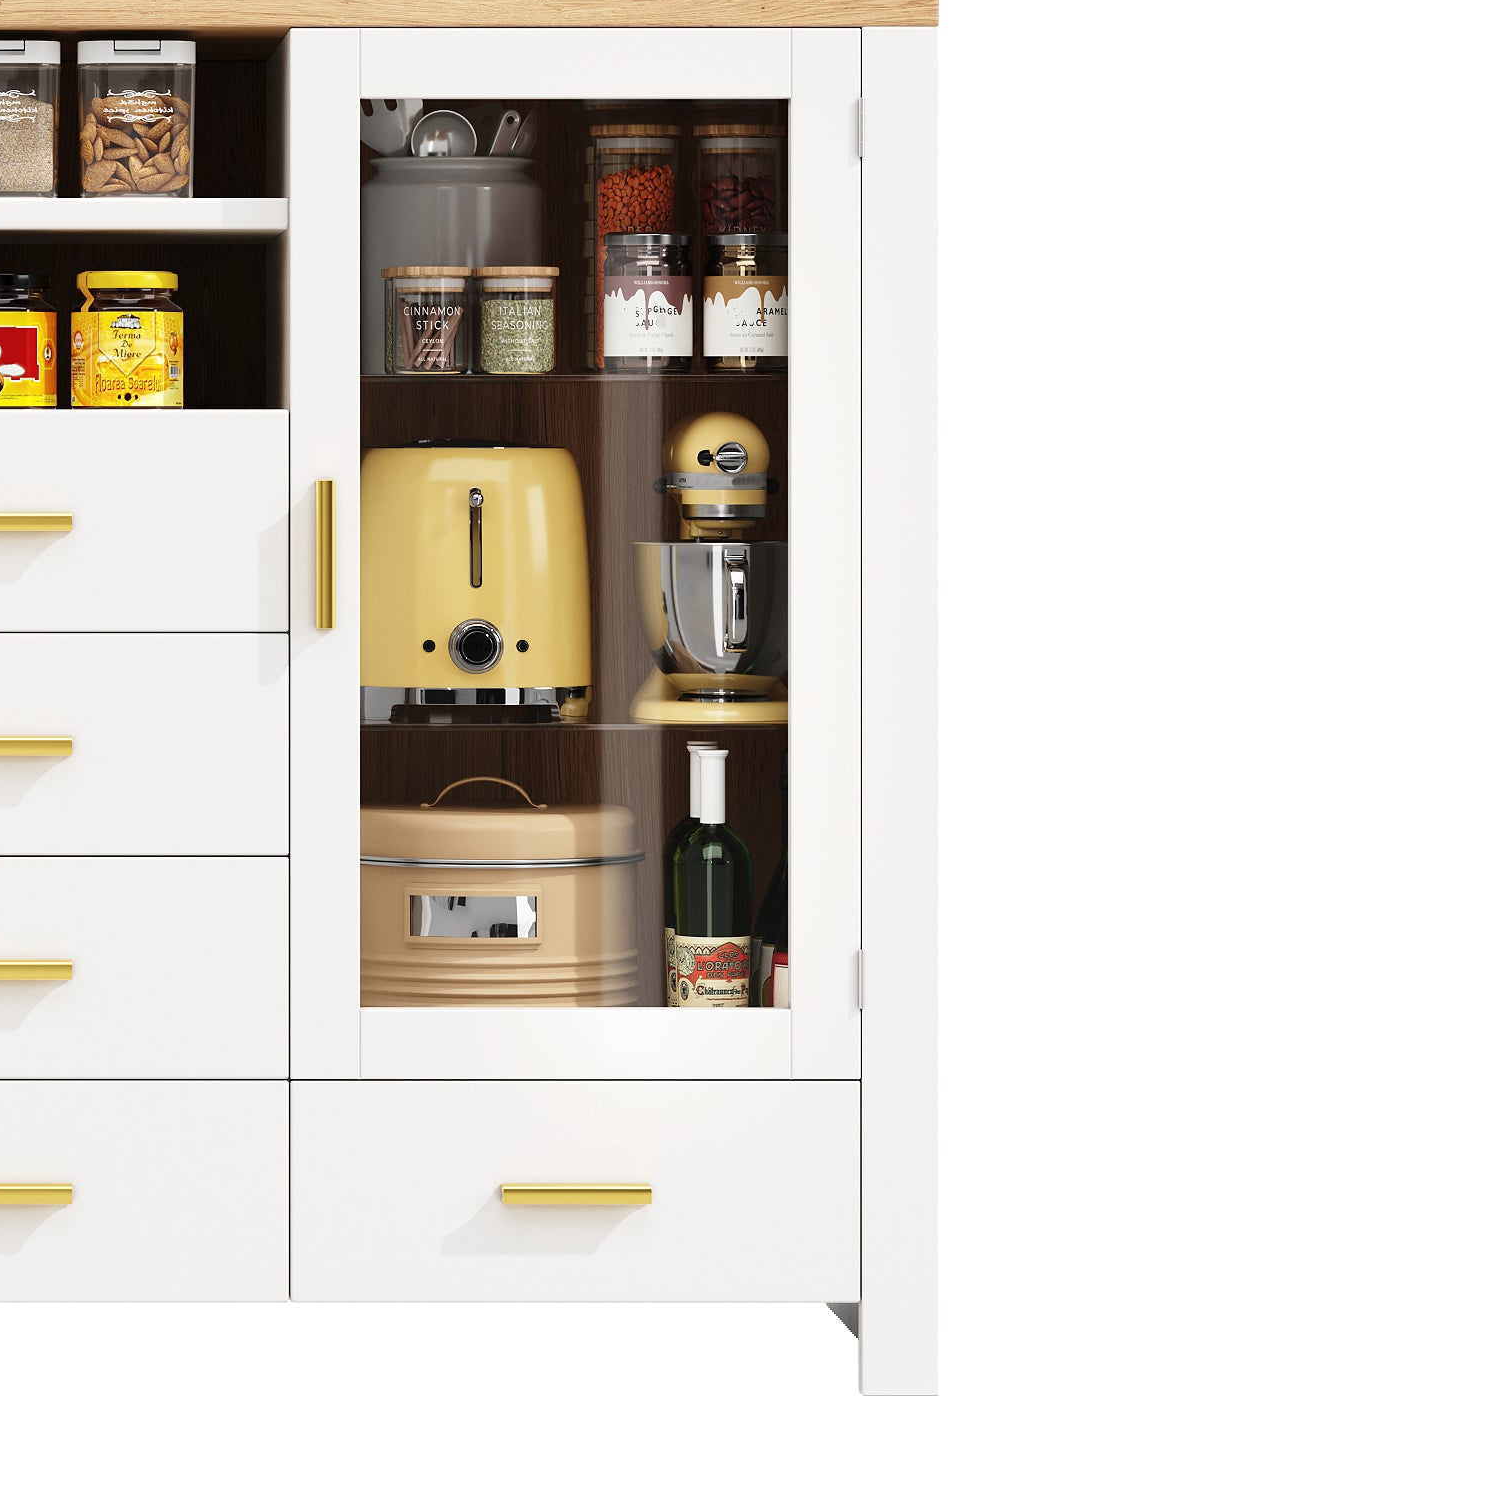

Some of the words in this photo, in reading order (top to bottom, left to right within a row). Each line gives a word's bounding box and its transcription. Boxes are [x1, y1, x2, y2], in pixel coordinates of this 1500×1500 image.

[403, 307, 461, 316] CINNAMON
[499, 307, 541, 316] ITALIAN
[416, 321, 450, 330] STICK
[491, 321, 549, 330] SEASONING
[718, 951, 739, 959] CLOS
